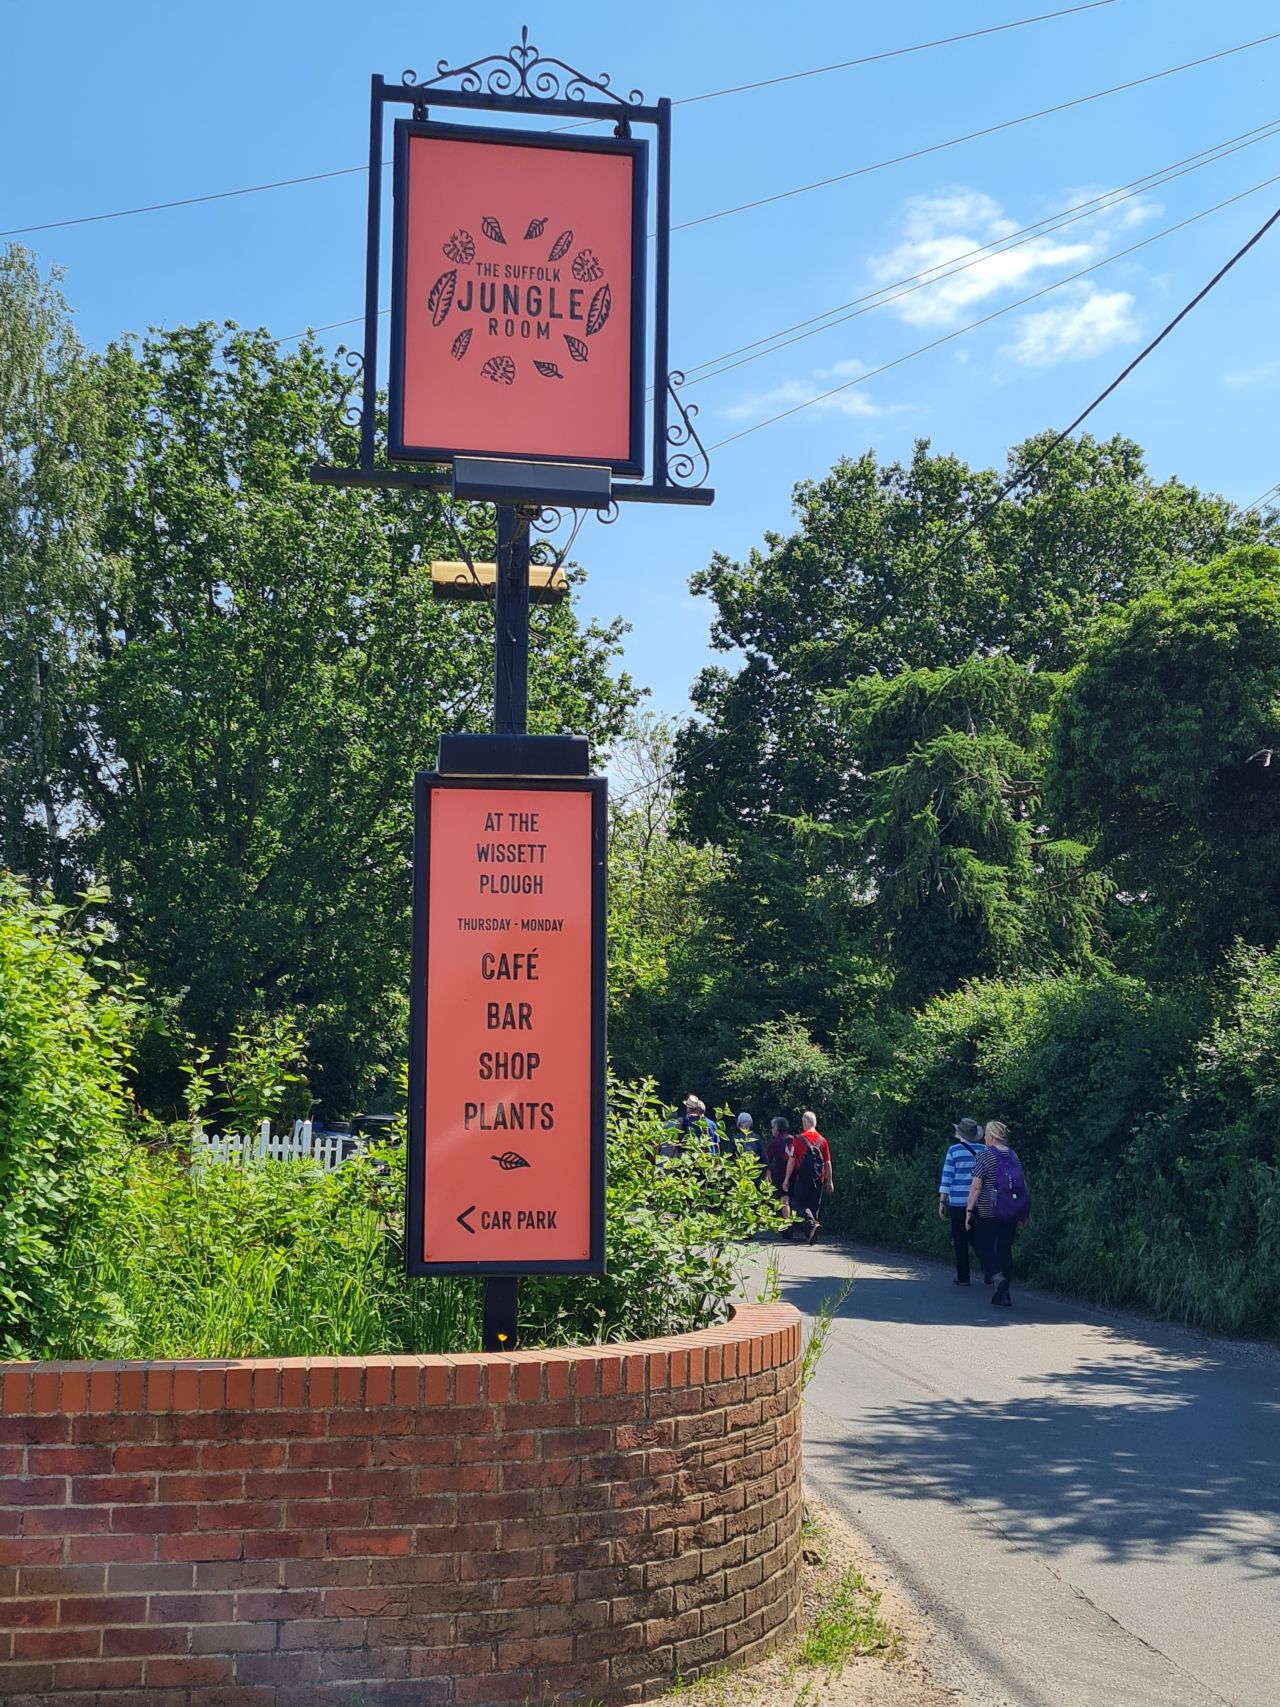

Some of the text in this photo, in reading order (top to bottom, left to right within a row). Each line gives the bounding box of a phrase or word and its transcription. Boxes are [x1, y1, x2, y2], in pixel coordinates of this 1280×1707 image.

[476, 263, 561, 282] THE SUFFOLK
[458, 281, 584, 320] JUNGLE
[489, 318, 550, 340] ROOM
[484, 812, 538, 832] AT THE
[477, 844, 546, 863] WISSETT
[480, 875, 542, 894] PLOUGH
[458, 918, 511, 930] THURSDAY
[522, 919, 563, 931] MONDAY
[482, 948, 538, 980] CAFÉ
[488, 1003, 532, 1030] BAR
[480, 1052, 540, 1080] SHOP
[465, 1103, 553, 1130] PLANTS
[482, 1211, 556, 1229] CAR PARK
